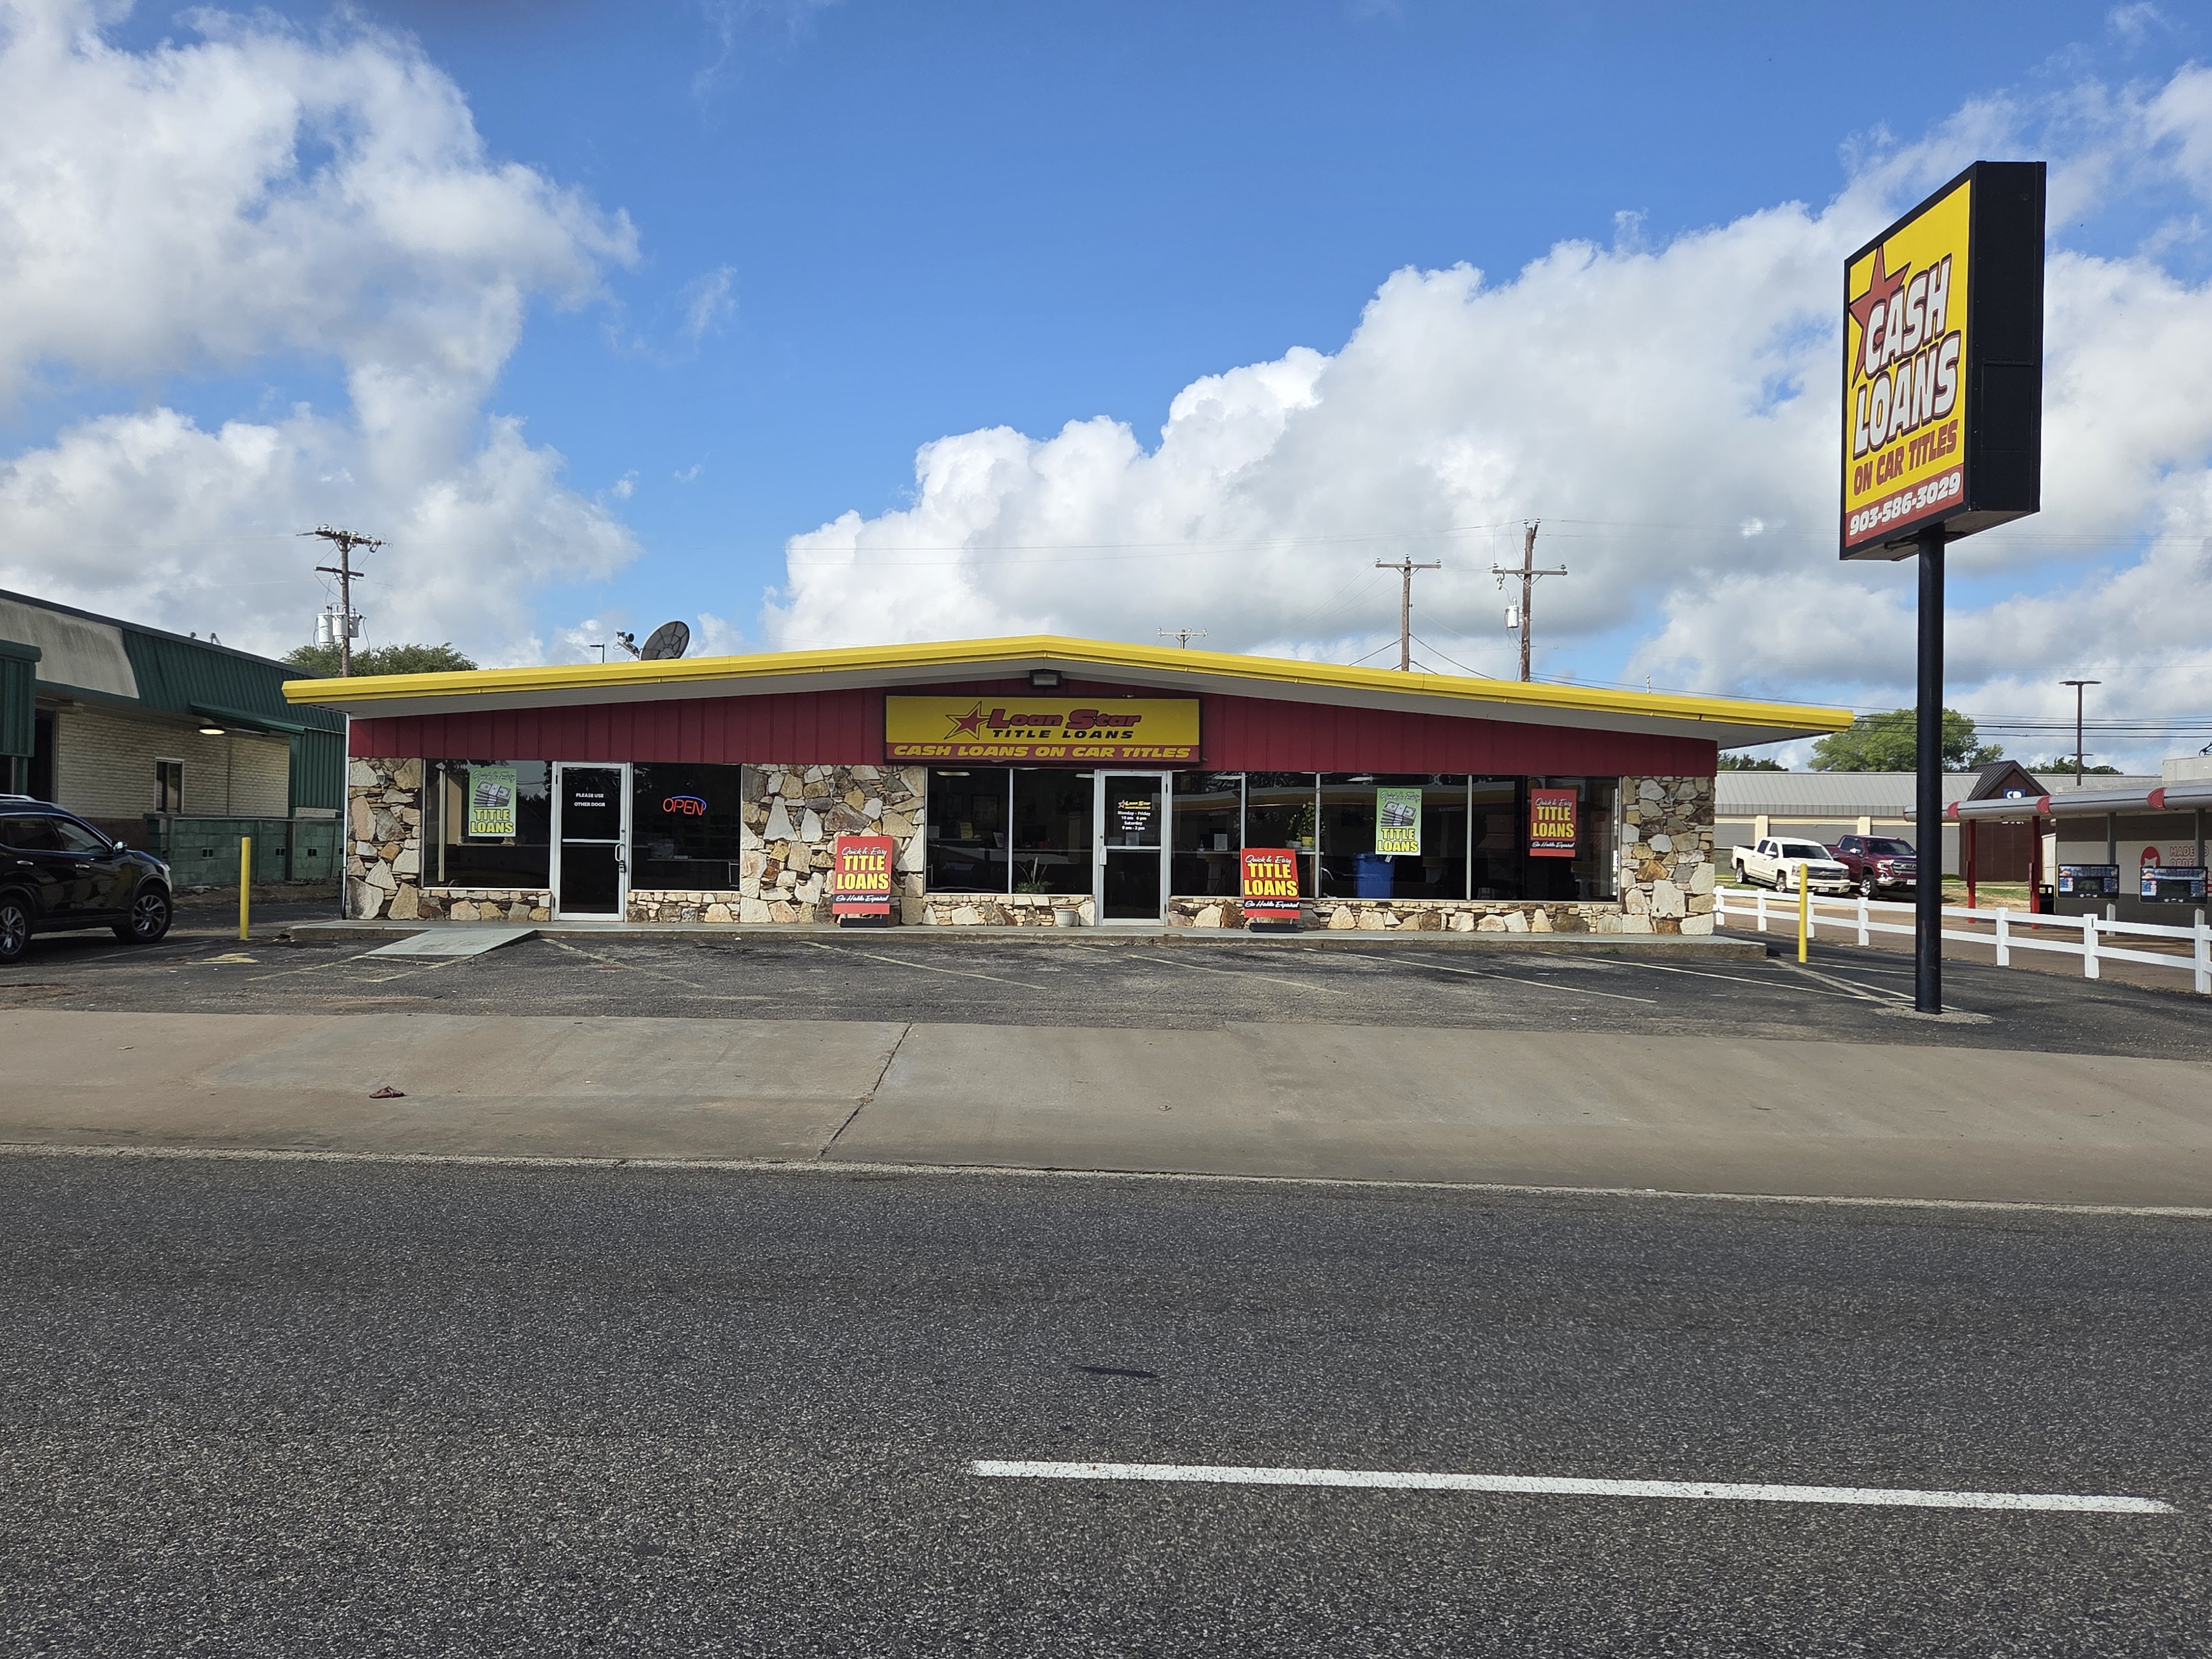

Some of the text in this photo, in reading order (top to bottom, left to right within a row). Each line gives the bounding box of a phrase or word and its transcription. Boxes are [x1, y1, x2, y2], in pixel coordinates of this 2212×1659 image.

[1864, 253, 1952, 380] CASH
[1853, 330, 1961, 461] LOANS
[1854, 419, 1959, 496] ON CAR TITLES
[1849, 472, 1961, 536] 903-586-3029
[986, 708, 1142, 729] Loan Star
[993, 729, 1134, 739] TITLE LOANS
[894, 745, 1191, 758] CASH LOANS ON CAR TITLES
[662, 798, 704, 816] OPEN
[1536, 806, 1571, 821] TITLE
[474, 809, 510, 821] TITLE
[471, 821, 514, 834] LOANS
[1381, 828, 1415, 840] TITLE
[1532, 822, 1574, 838] LOANS
[842, 847, 862, 855] Quick
[870, 847, 888, 857] Easy
[1378, 840, 1419, 852] LOANS
[2169, 846, 2195, 857] MADE
[843, 855, 885, 871] TITLE
[1245, 855, 1266, 864] Quick
[1275, 855, 1292, 865] Easy
[1247, 863, 1292, 878] TITLE
[836, 873, 889, 890] LOANS
[1244, 879, 1298, 896] LOANS
